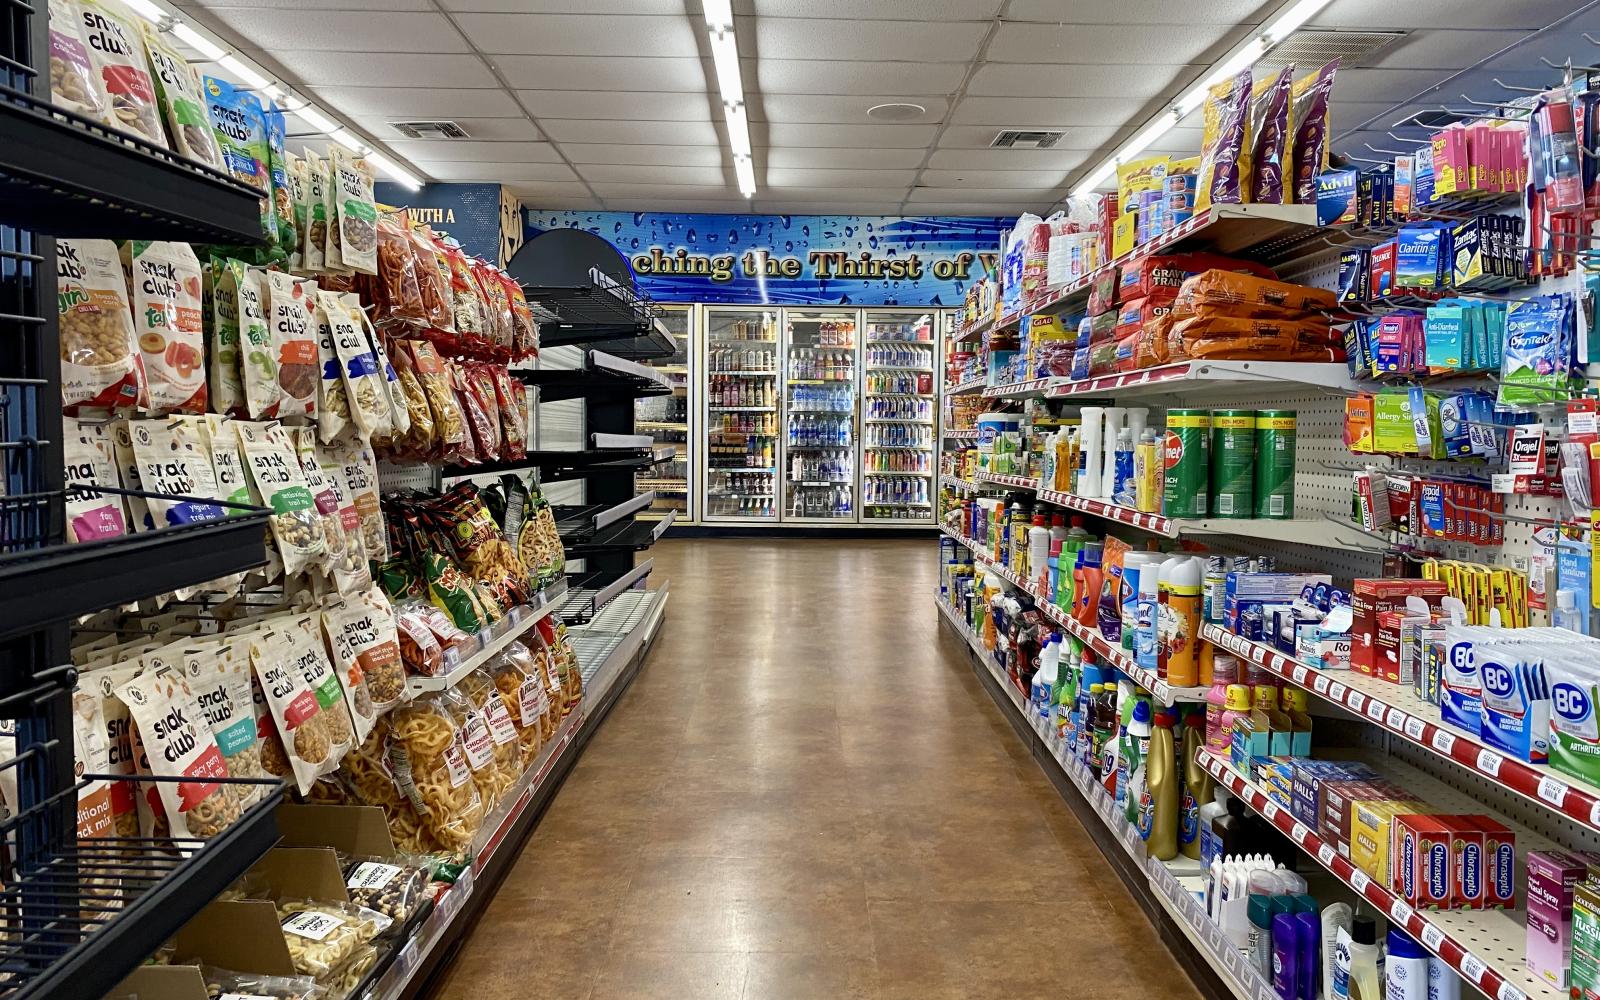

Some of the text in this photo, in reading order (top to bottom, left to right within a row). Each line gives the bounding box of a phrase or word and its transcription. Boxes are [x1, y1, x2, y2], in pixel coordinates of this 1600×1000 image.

[212, 103, 247, 126] snak
[217, 122, 247, 141] club
[1432, 137, 1447, 152] Pepto
[1318, 174, 1353, 192] Advil
[408, 208, 443, 224] WITH
[446, 208, 456, 224] A
[1453, 227, 1477, 246] Zantac
[1491, 231, 1500, 257] Zantac
[1503, 232, 1512, 258] Zantac
[1399, 243, 1430, 255] Claritin
[140, 259, 177, 281] snak
[742, 249, 799, 277] the
[809, 251, 921, 279] Thirst
[932, 252, 972, 279] of
[1152, 268, 1187, 279] GRAVY
[1152, 276, 1185, 288] TRAIN
[142, 278, 177, 299] club
[278, 321, 304, 335] club
[1033, 316, 1052, 327] GLAD
[1383, 323, 1399, 332] Benadryl
[1428, 322, 1459, 331] Anti-Diarrheal
[1480, 331, 1488, 366] Anti-Diarrheal
[1510, 333, 1552, 348] DenTek
[1376, 412, 1401, 424] Allergy
[1514, 439, 1538, 454] Orajel
[254, 452, 286, 467] snak
[1512, 453, 1520, 462] 3X
[148, 458, 189, 477] snak
[155, 477, 192, 496] club
[190, 513, 205, 522] trail
[1361, 498, 1371, 531] EXCEDRIN
[1560, 556, 1578, 567] Hand
[1561, 566, 1586, 579] Sanitizer
[1364, 603, 1374, 611] Fever
[1375, 604, 1393, 612] Pain &
[344, 615, 373, 634] snak
[348, 632, 376, 647] club
[297, 648, 320, 670] snak
[303, 662, 325, 684] club
[1484, 667, 1509, 692] BC
[197, 685, 229, 709] snak
[272, 680, 295, 699] club
[1229, 689, 1234, 698] 5
[1261, 689, 1267, 699] 5
[1287, 688, 1293, 698] 5
[1555, 688, 1583, 715] BC
[153, 706, 189, 740] snak
[1501, 718, 1523, 727] HEADACHES
[1502, 723, 1511, 731] BODY
[227, 725, 246, 739] salted
[164, 730, 196, 762] club
[227, 734, 252, 751] peanuts
[1569, 742, 1600, 755] ARTHRITIS
[206, 754, 220, 770] party
[1294, 780, 1315, 801] HALLS
[95, 813, 112, 832] mix
[1358, 833, 1377, 850] HALLS
[1431, 845, 1443, 896] Chloraseptic
[1465, 845, 1477, 896] Chloraseptic
[1498, 845, 1510, 896] Chloraseptic
[1528, 880, 1559, 907] Nasal Spray
[1542, 922, 1549, 935] 12
